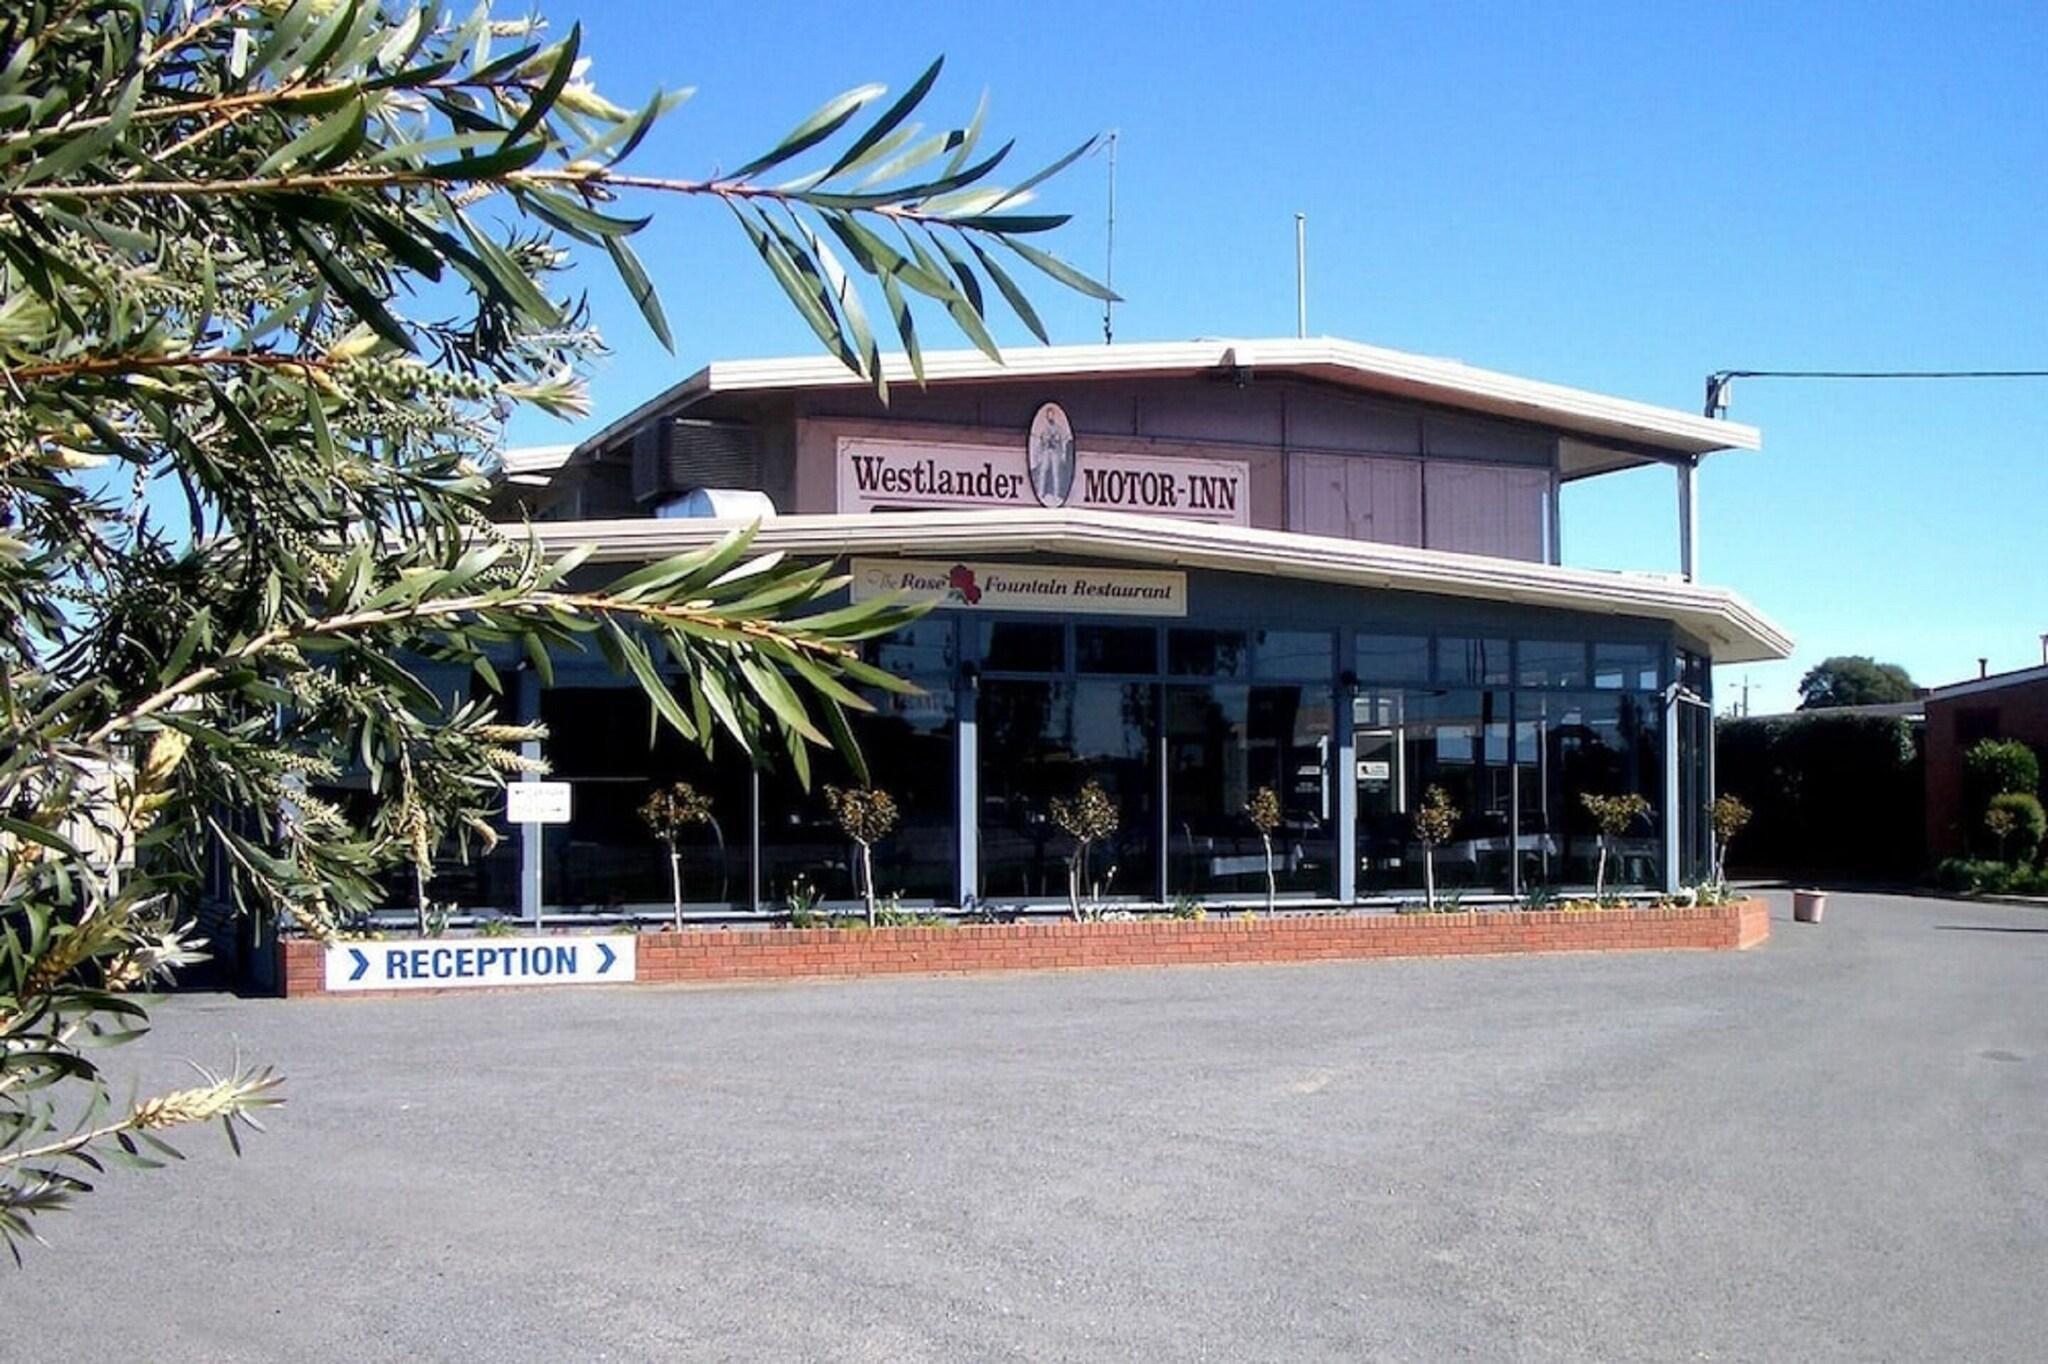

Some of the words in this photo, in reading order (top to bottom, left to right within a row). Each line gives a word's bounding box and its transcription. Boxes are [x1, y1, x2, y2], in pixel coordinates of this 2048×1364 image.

[852, 455, 1023, 499] Westlander
[1083, 468, 1238, 510] MOTOR-INN
[900, 573, 946, 590] Rose
[985, 576, 1067, 595] Fountain
[1073, 579, 1172, 599] Restaurant
[386, 946, 577, 979] RECEPTION
